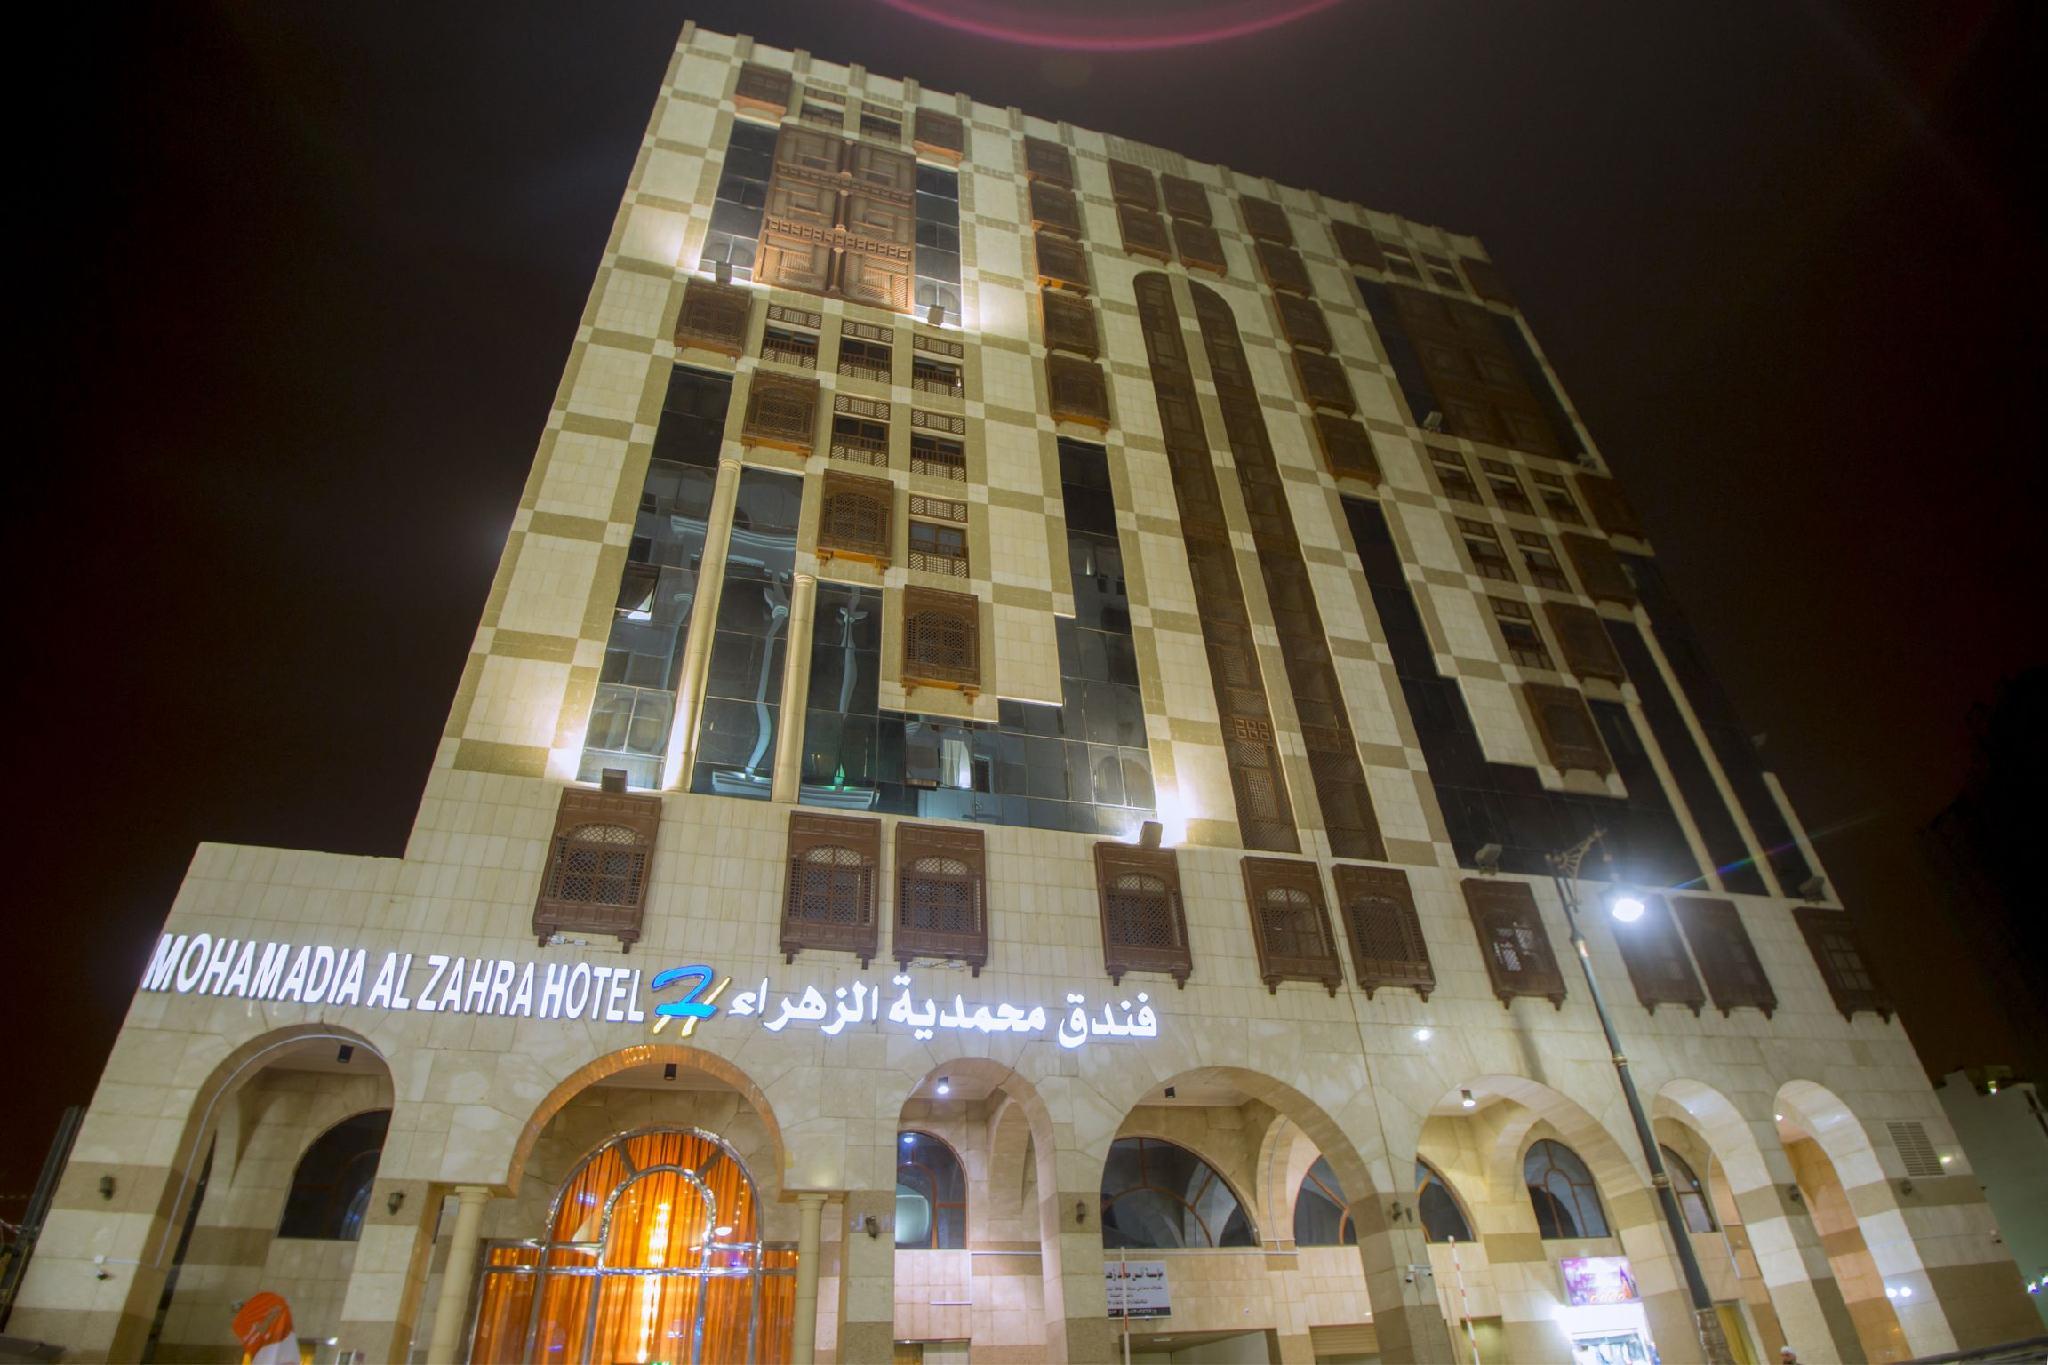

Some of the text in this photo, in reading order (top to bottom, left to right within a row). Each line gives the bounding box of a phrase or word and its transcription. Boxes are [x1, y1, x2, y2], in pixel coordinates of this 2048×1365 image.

[142, 934, 366, 1005] MOHAMADIA
[366, 952, 412, 1009] AL
[416, 955, 534, 1017] ZAHRA
[539, 963, 645, 1022] HOTEL
[728, 974, 1158, 1049] فندق محمدية الزهراء
